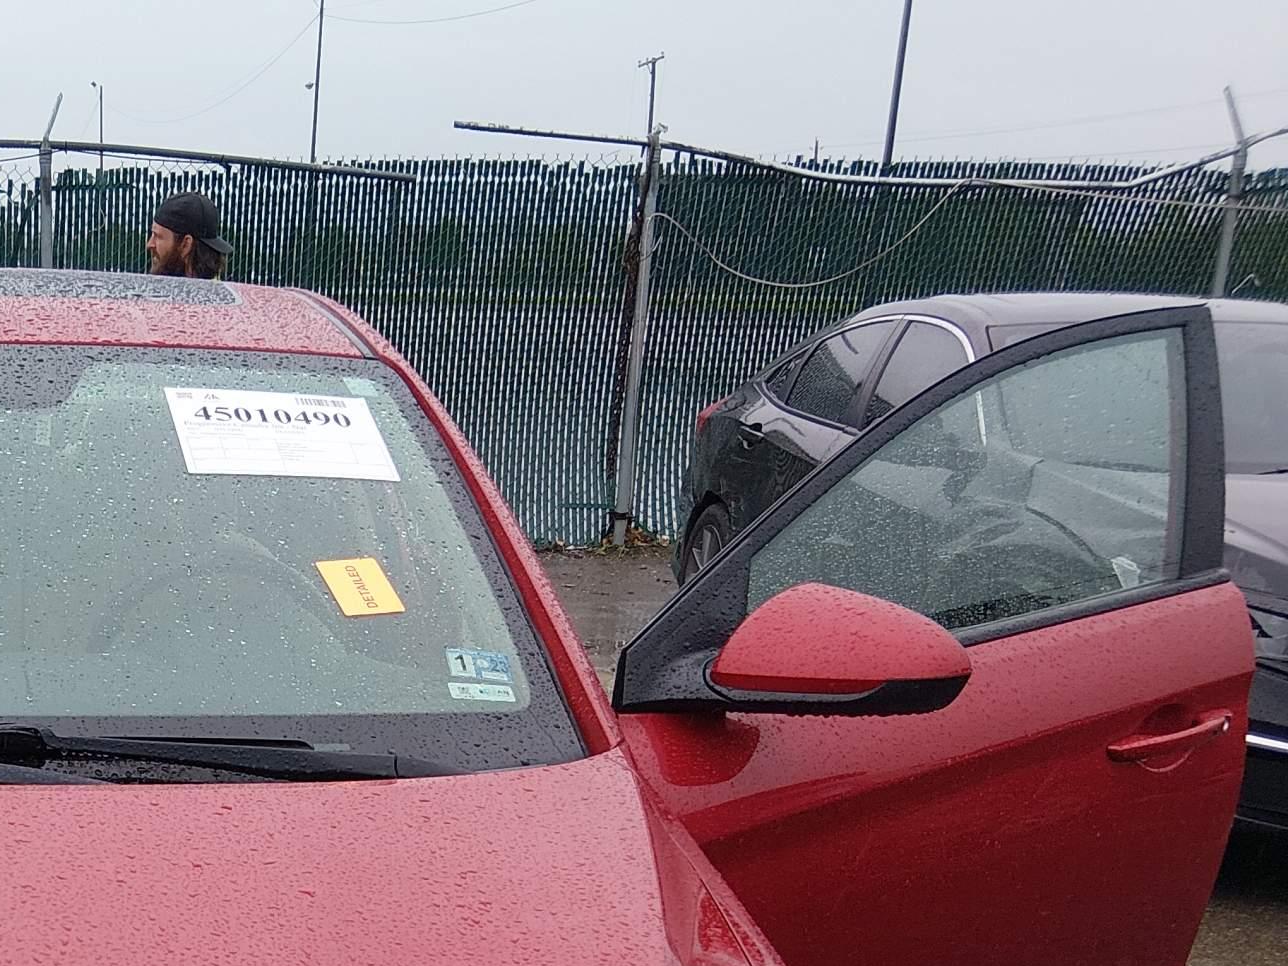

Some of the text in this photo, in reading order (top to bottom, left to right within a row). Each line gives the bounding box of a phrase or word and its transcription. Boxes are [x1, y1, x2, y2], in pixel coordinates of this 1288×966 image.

[194, 406, 351, 428] 45010490
[344, 565, 379, 609] DETAILED
[454, 654, 467, 671] 1
